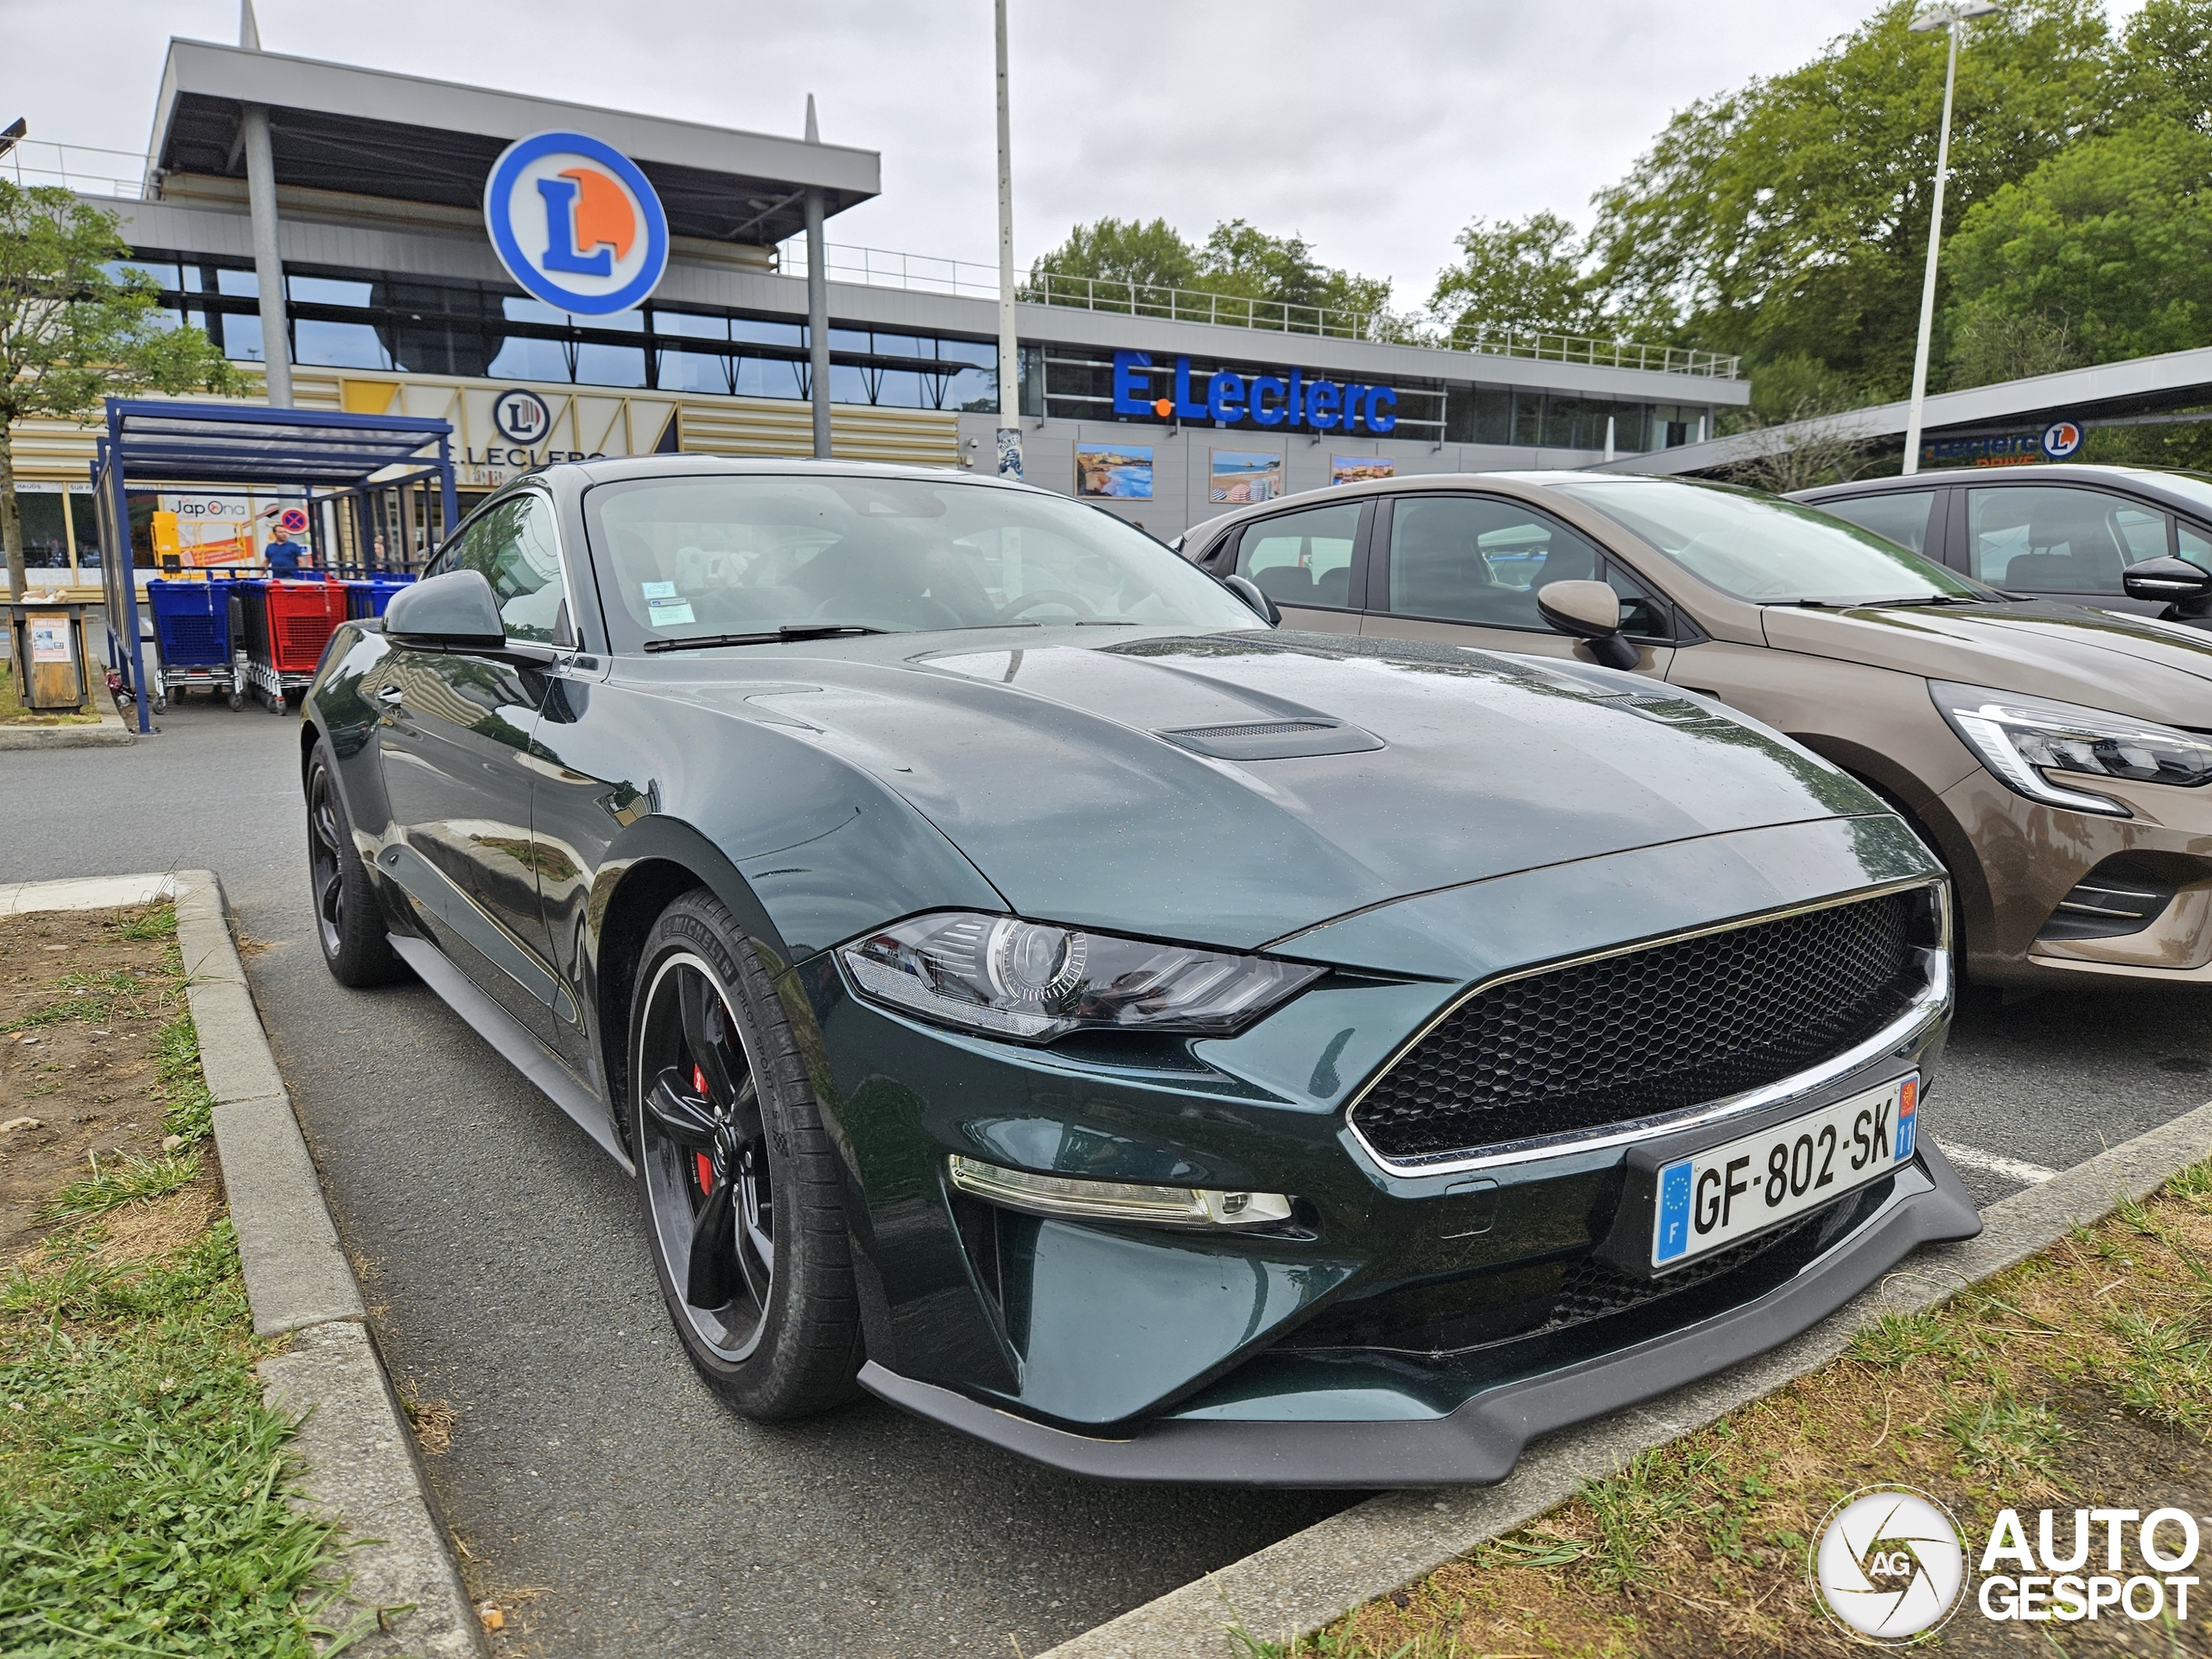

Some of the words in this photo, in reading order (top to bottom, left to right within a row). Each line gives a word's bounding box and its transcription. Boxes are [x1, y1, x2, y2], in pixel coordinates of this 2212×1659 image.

[1113, 350, 1397, 432] E.Leclerc
[1976, 454, 2037, 467] DRIVE
[674, 916, 734, 980] MICHELIN
[737, 989, 758, 1029] PILOT
[753, 1036, 775, 1091] SPORT
[1694, 1098, 1894, 1236] GF-802-SK
[1899, 1121, 1913, 1154] 11
[1669, 1221, 1680, 1244] F
